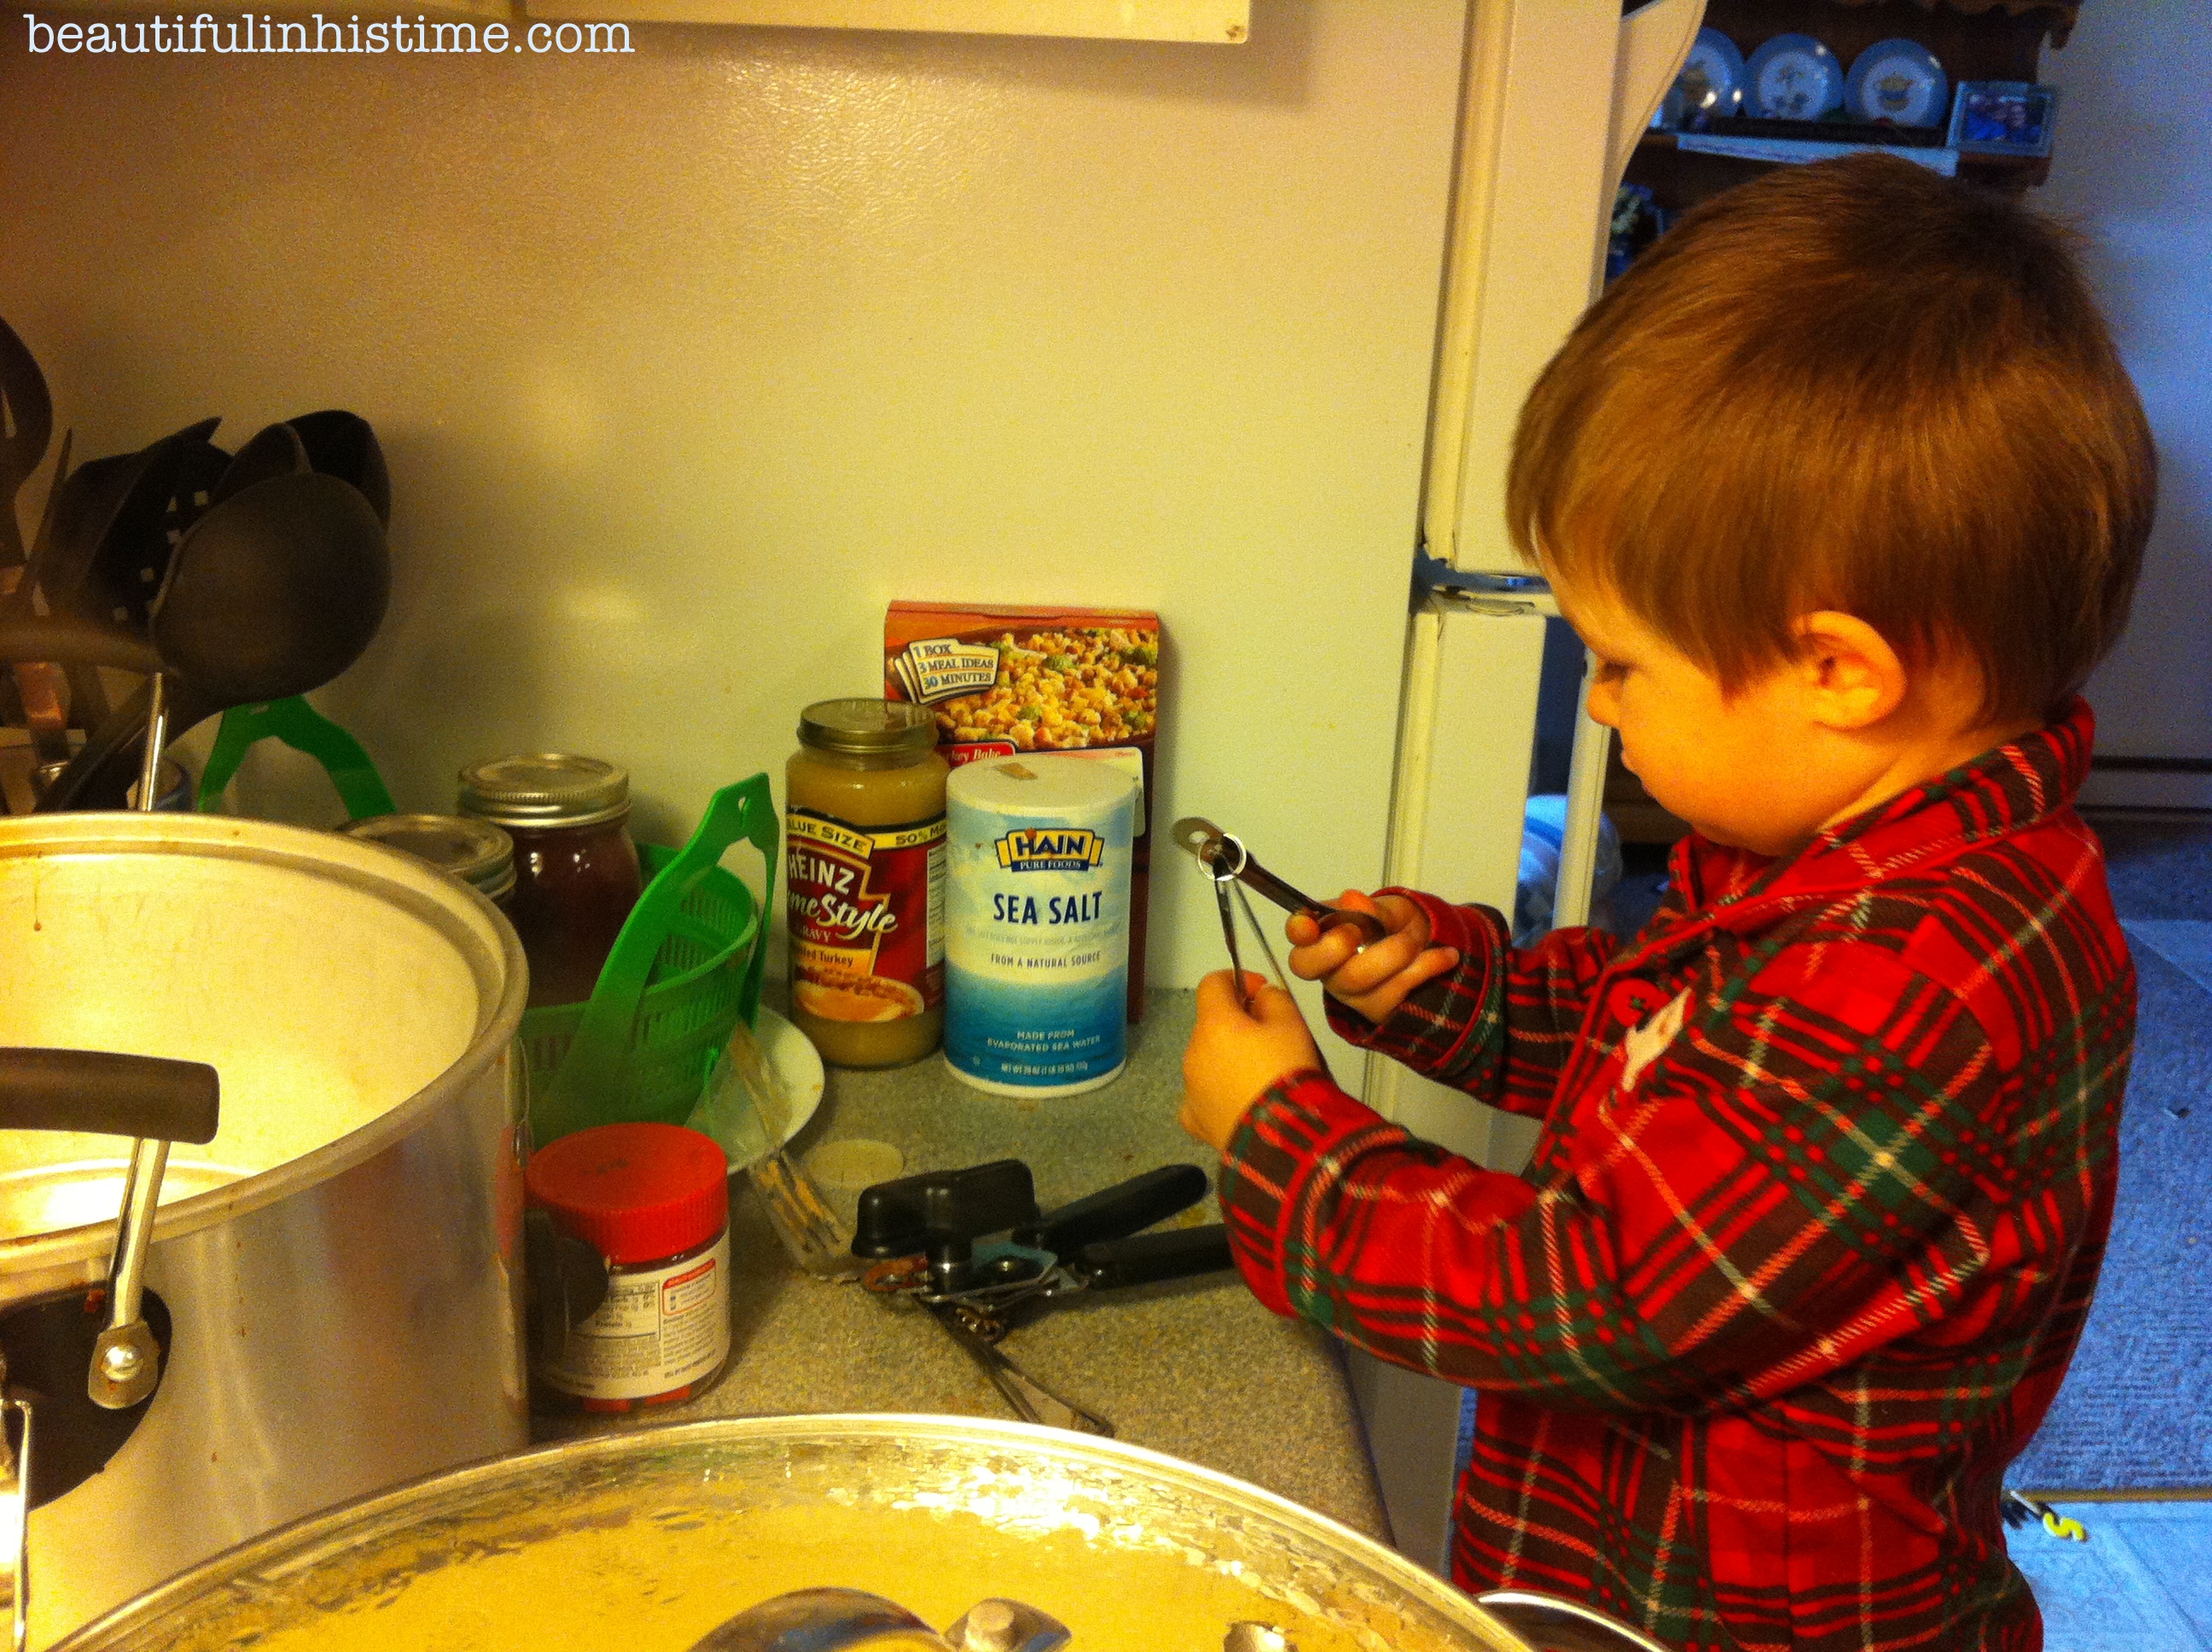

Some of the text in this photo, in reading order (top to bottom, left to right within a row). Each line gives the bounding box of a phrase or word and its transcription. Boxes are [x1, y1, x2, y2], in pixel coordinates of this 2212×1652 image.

[913, 644, 952, 657] 1 BOX
[918, 658, 993, 673] 3 MEAL IDEAS
[923, 673, 991, 689] 30 MINUTES
[821, 824, 868, 850] SIZE
[896, 830, 928, 846] 50%
[1016, 835, 1086, 857] HAIN
[789, 853, 855, 895] HEINZ
[1020, 860, 1081, 870] PURE FOODS
[788, 889, 899, 940] meStyle
[993, 891, 1103, 925] SEA SALT
[802, 925, 831, 943] RAVY
[820, 951, 853, 969] Turkey
[991, 951, 1101, 969] FROM A NATURAL SOURCE
[987, 1035, 1101, 1053] EVAPORATED SEA WATER
[1016, 1029, 1075, 1041] MADE FROM
